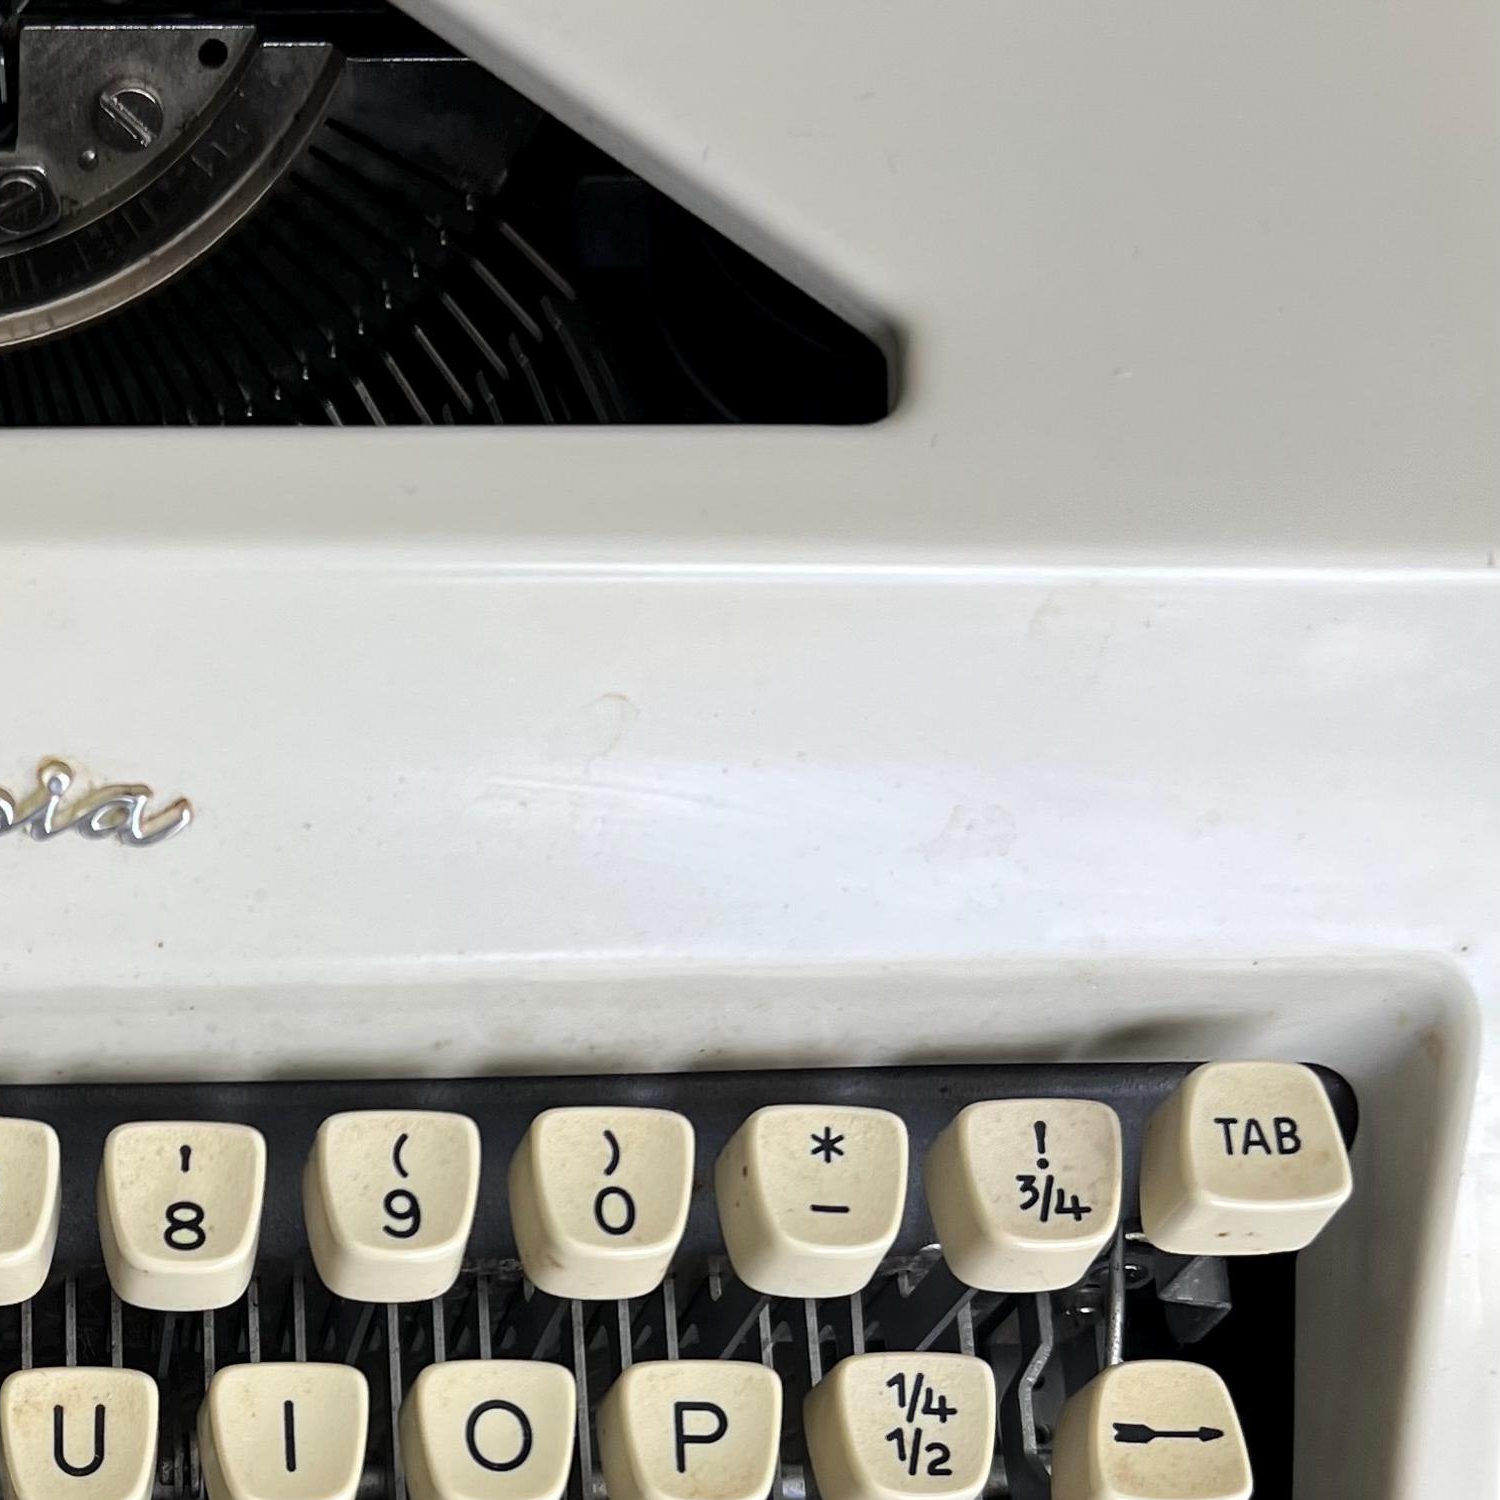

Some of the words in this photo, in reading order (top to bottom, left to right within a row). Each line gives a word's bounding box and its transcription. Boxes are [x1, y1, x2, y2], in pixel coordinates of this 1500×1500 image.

[1214, 1117, 1301, 1155] TAB
[164, 1201, 206, 1251] 8
[383, 1189, 421, 1238] 9
[594, 1186, 635, 1235] 0
[54, 1404, 105, 1477] U
[284, 1401, 296, 1472] I
[466, 1400, 532, 1472] O
[675, 1402, 728, 1473] P
